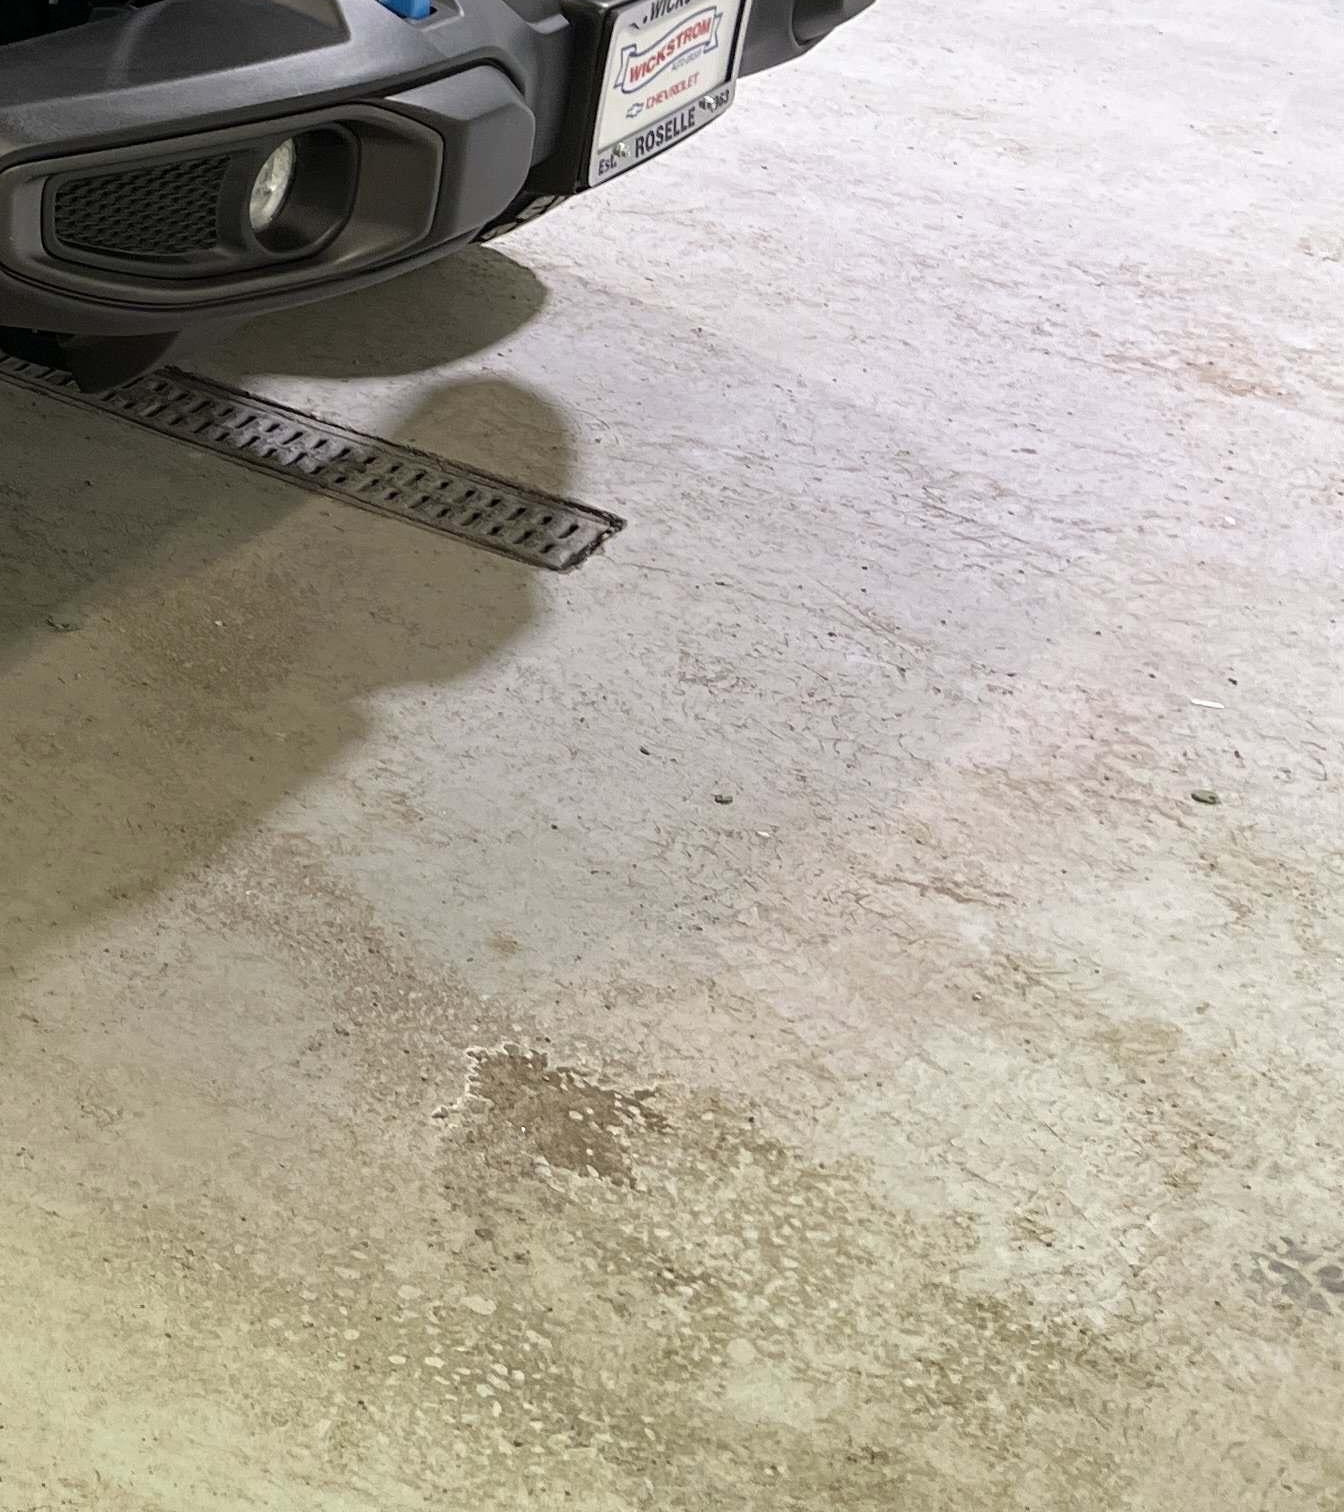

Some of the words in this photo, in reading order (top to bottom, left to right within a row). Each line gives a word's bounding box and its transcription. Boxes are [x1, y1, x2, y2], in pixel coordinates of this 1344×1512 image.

[629, 17, 713, 83] WICKSTROM
[645, 71, 700, 110] CHEVROLET
[635, 106, 696, 158] ROSELLE
